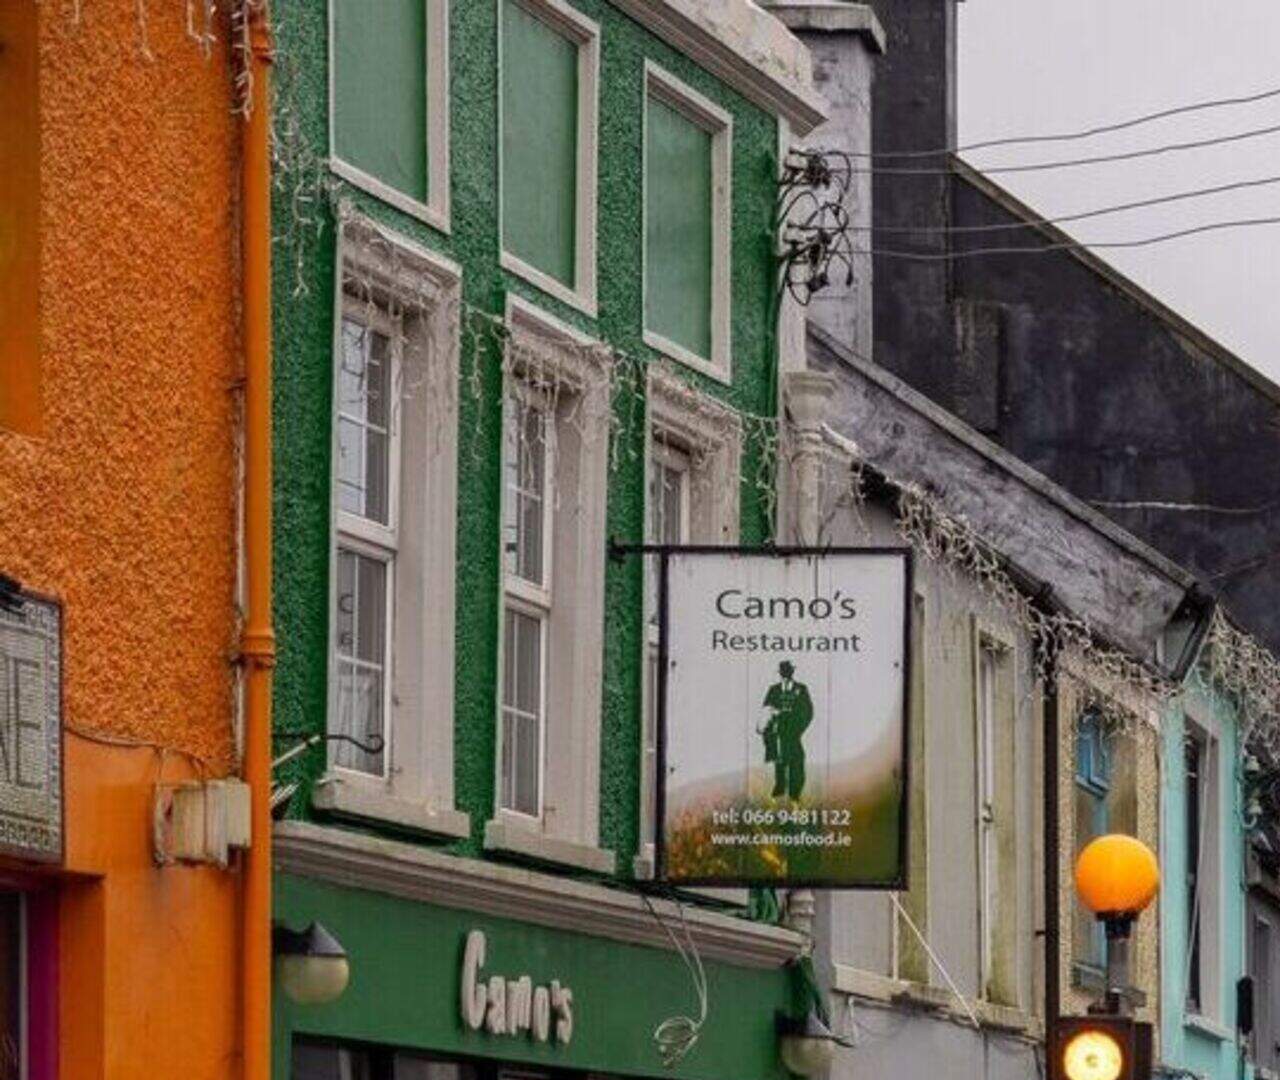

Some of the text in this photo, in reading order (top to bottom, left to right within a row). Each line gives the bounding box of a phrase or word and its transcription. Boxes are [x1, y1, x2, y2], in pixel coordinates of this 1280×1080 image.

[716, 589, 857, 620] Camo's
[712, 629, 861, 652] Restaurant
[712, 808, 851, 826] tel: 066 9481122
[710, 831, 852, 847] www.camosfood.ie
[461, 929, 574, 1044] Camo's
